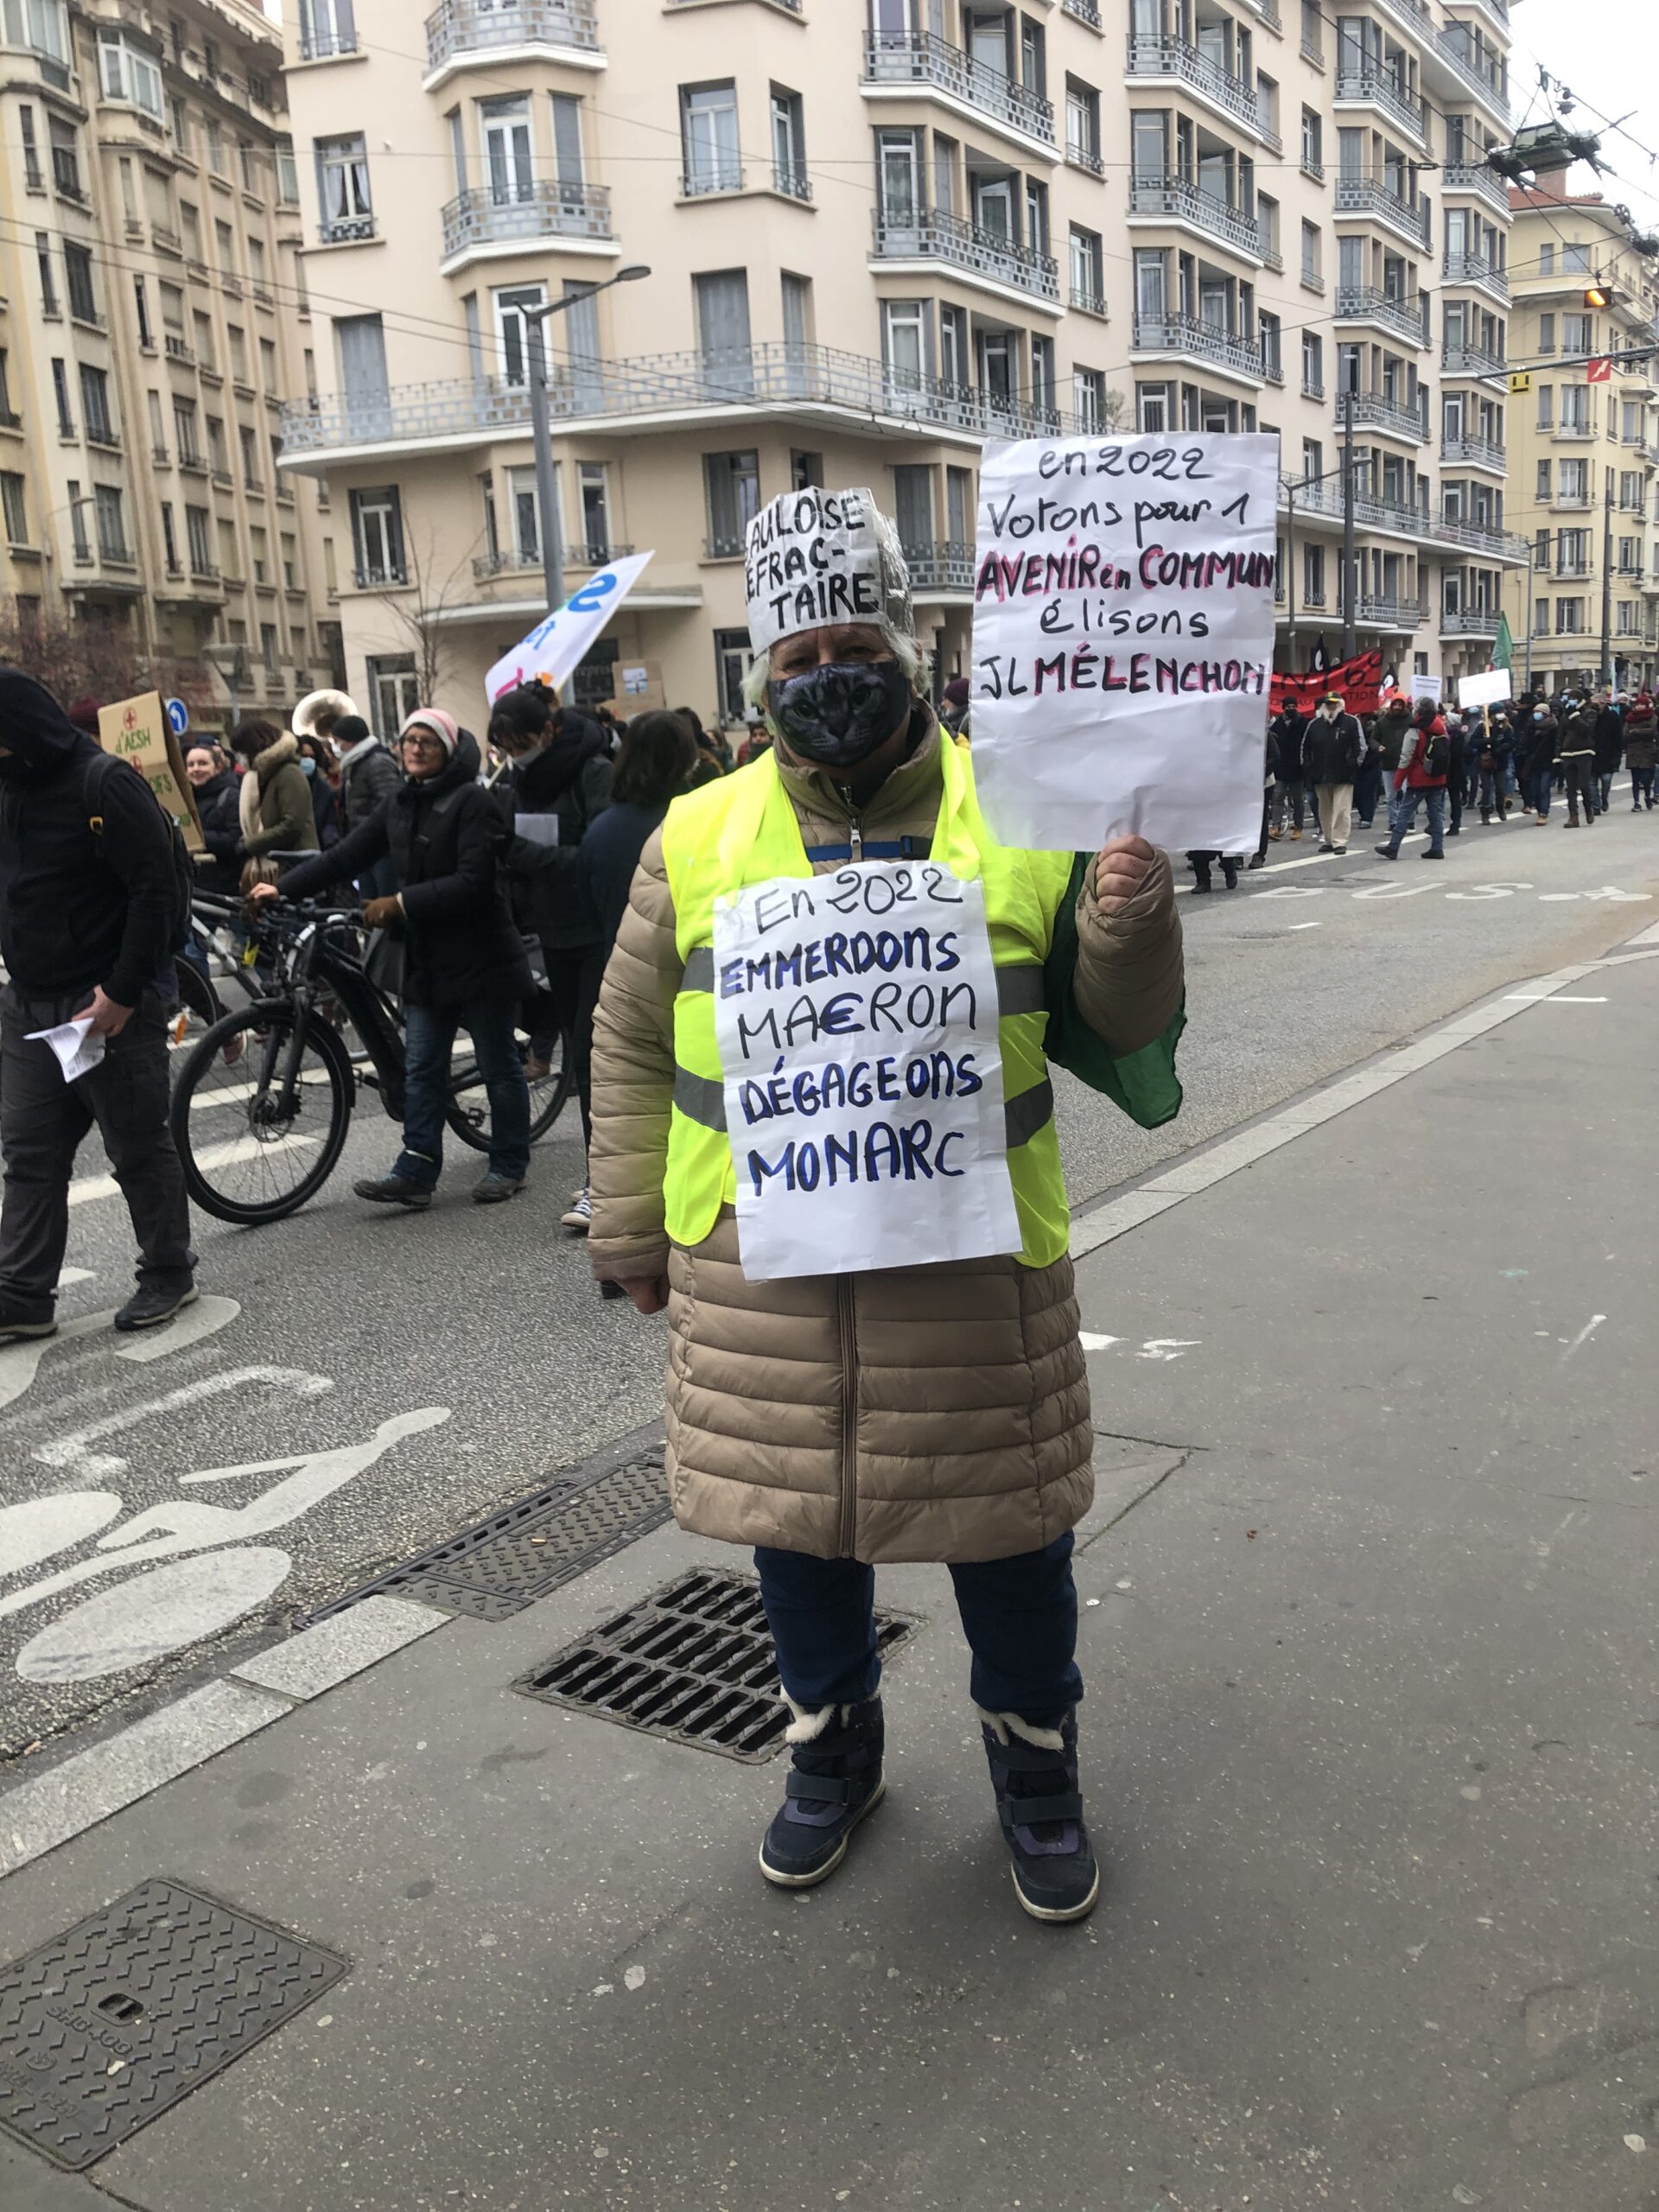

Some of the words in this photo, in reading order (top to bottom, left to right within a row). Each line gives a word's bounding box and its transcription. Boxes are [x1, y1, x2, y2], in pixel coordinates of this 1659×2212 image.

[1039, 448, 1087, 480] en
[1096, 445, 1215, 480] 2022
[988, 493, 1122, 538] Votons
[1135, 499, 1211, 549] pour
[1222, 493, 1250, 525] 1
[1138, 543, 1274, 590] COMMUN
[1039, 597, 1210, 638] élisons
[979, 655, 1027, 700] JL
[1034, 641, 1266, 696] MÉLENCHON
[754, 889, 815, 934] En
[826, 868, 964, 915] 2022
[747, 1119, 965, 1198] MONARC
